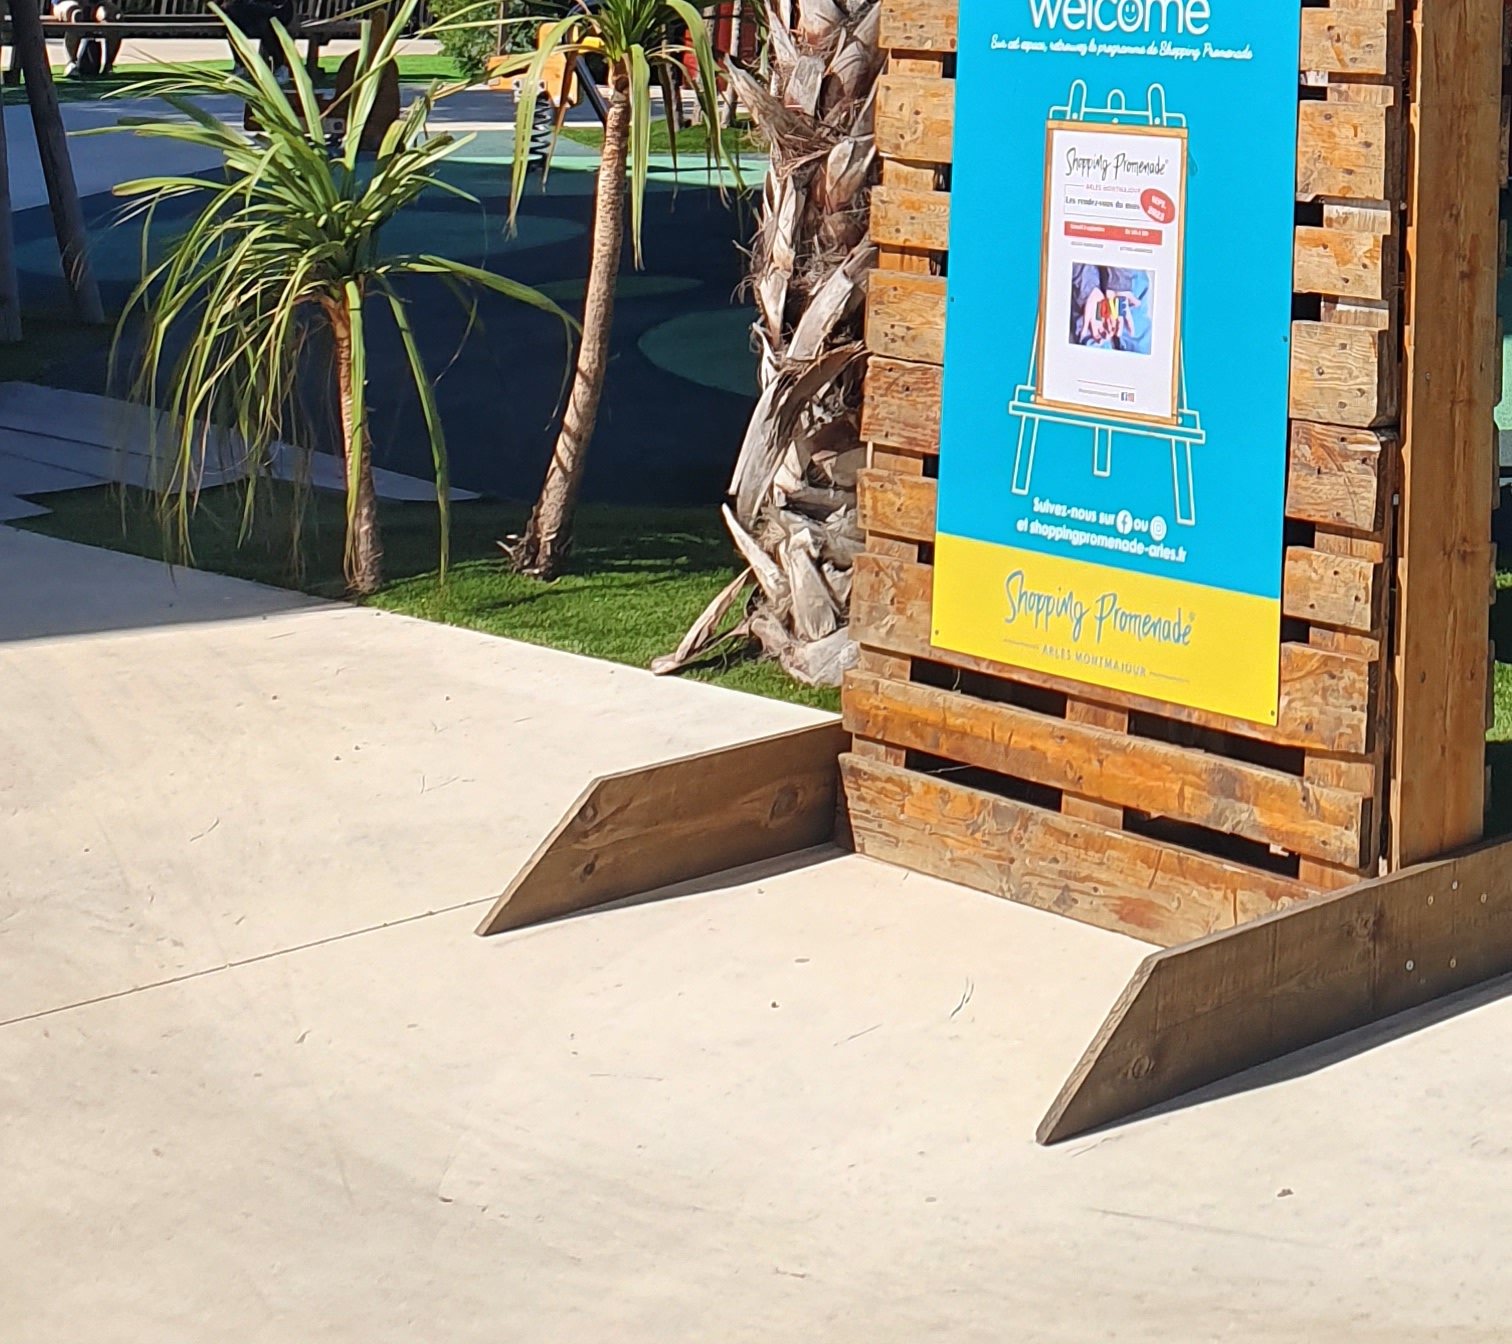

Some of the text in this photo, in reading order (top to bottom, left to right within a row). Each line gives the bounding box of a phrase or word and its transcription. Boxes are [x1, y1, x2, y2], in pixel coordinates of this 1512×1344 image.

[1096, 43, 1146, 59] programme
[1146, 40, 1158, 56] de
[1159, 40, 1201, 62] Shopping
[1202, 42, 1253, 60] Promenade
[1065, 146, 1166, 181] Shopping Promenade
[1032, 496, 1149, 533] Suivez-nous sur ou
[1016, 517, 1188, 564] et shoppingpromenade-arles.fr
[1003, 569, 1193, 647] Shopping Promenade
[1042, 643, 1147, 677] ARLES MONTMAJOUR
